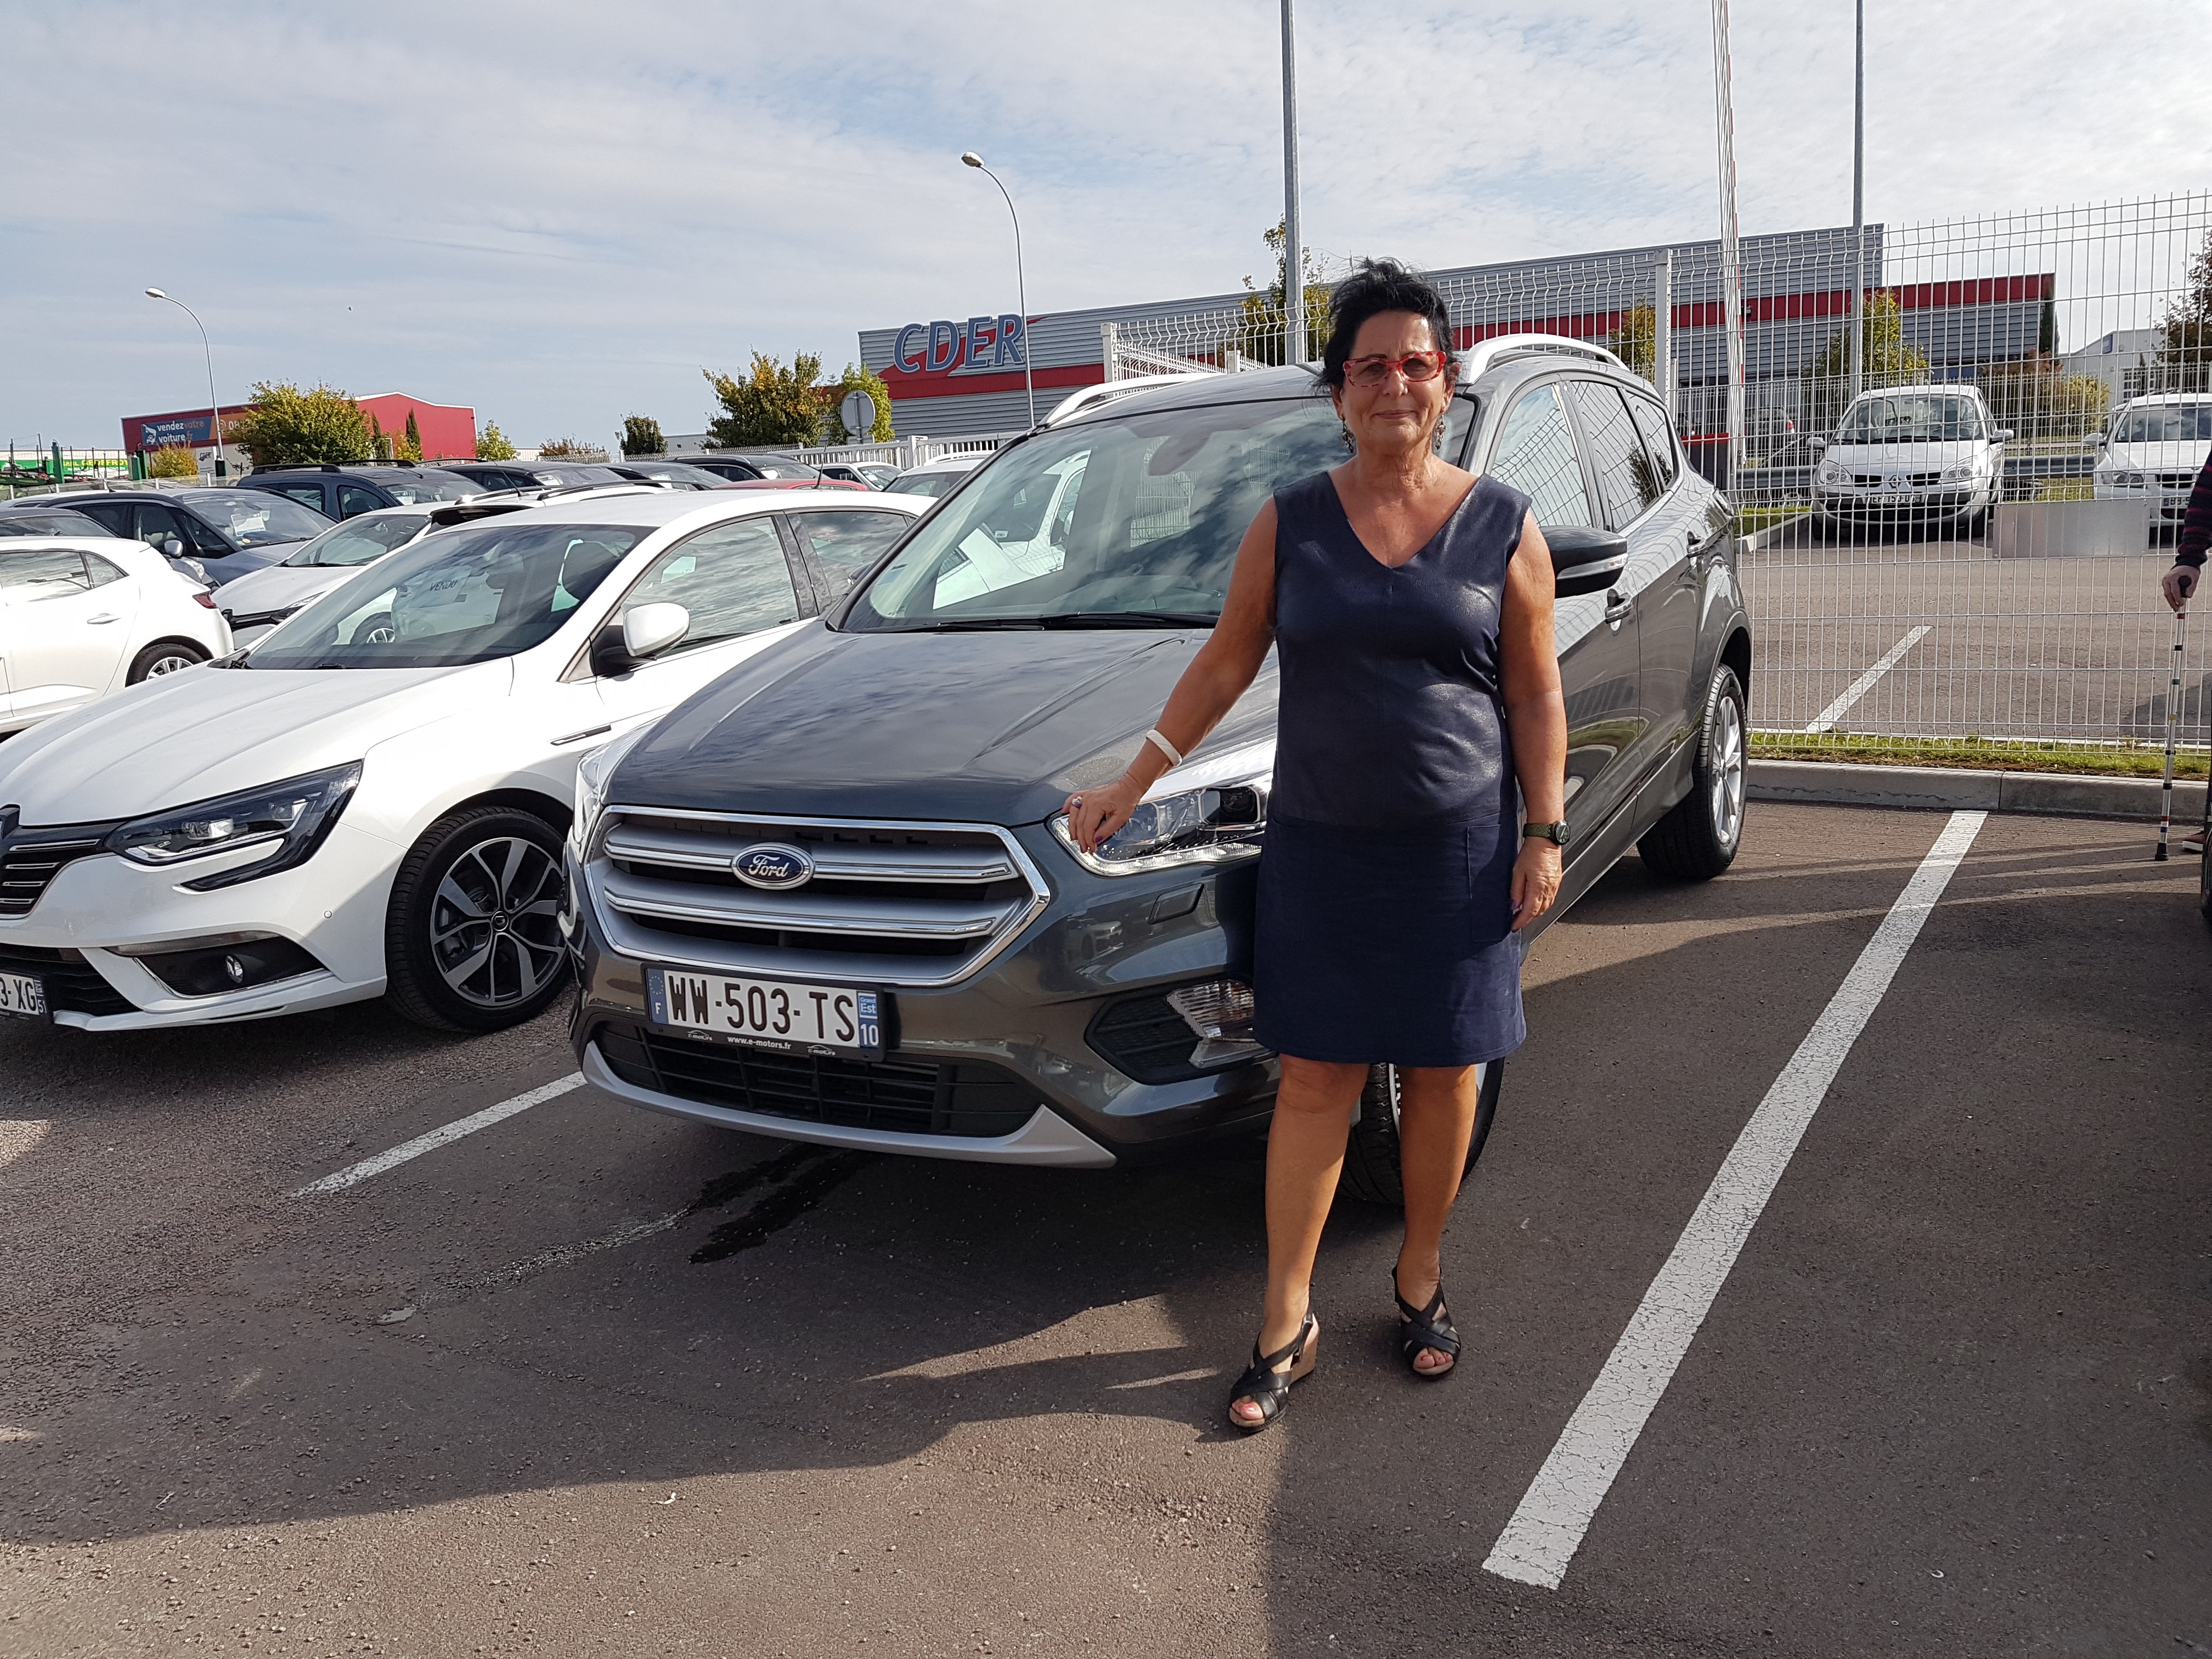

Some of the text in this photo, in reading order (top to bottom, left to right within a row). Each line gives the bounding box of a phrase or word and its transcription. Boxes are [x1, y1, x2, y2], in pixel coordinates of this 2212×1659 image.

[893, 314, 1025, 374] CDER
[430, 579, 458, 591] VENDU
[748, 854, 789, 877] Ford
[38, 1000, 47, 1014] 51
[655, 975, 855, 1042] F WW-503-TS
[860, 1002, 876, 1013] Est
[727, 1036, 791, 1049] www.e-motors.fr
[860, 1023, 879, 1046] 10
